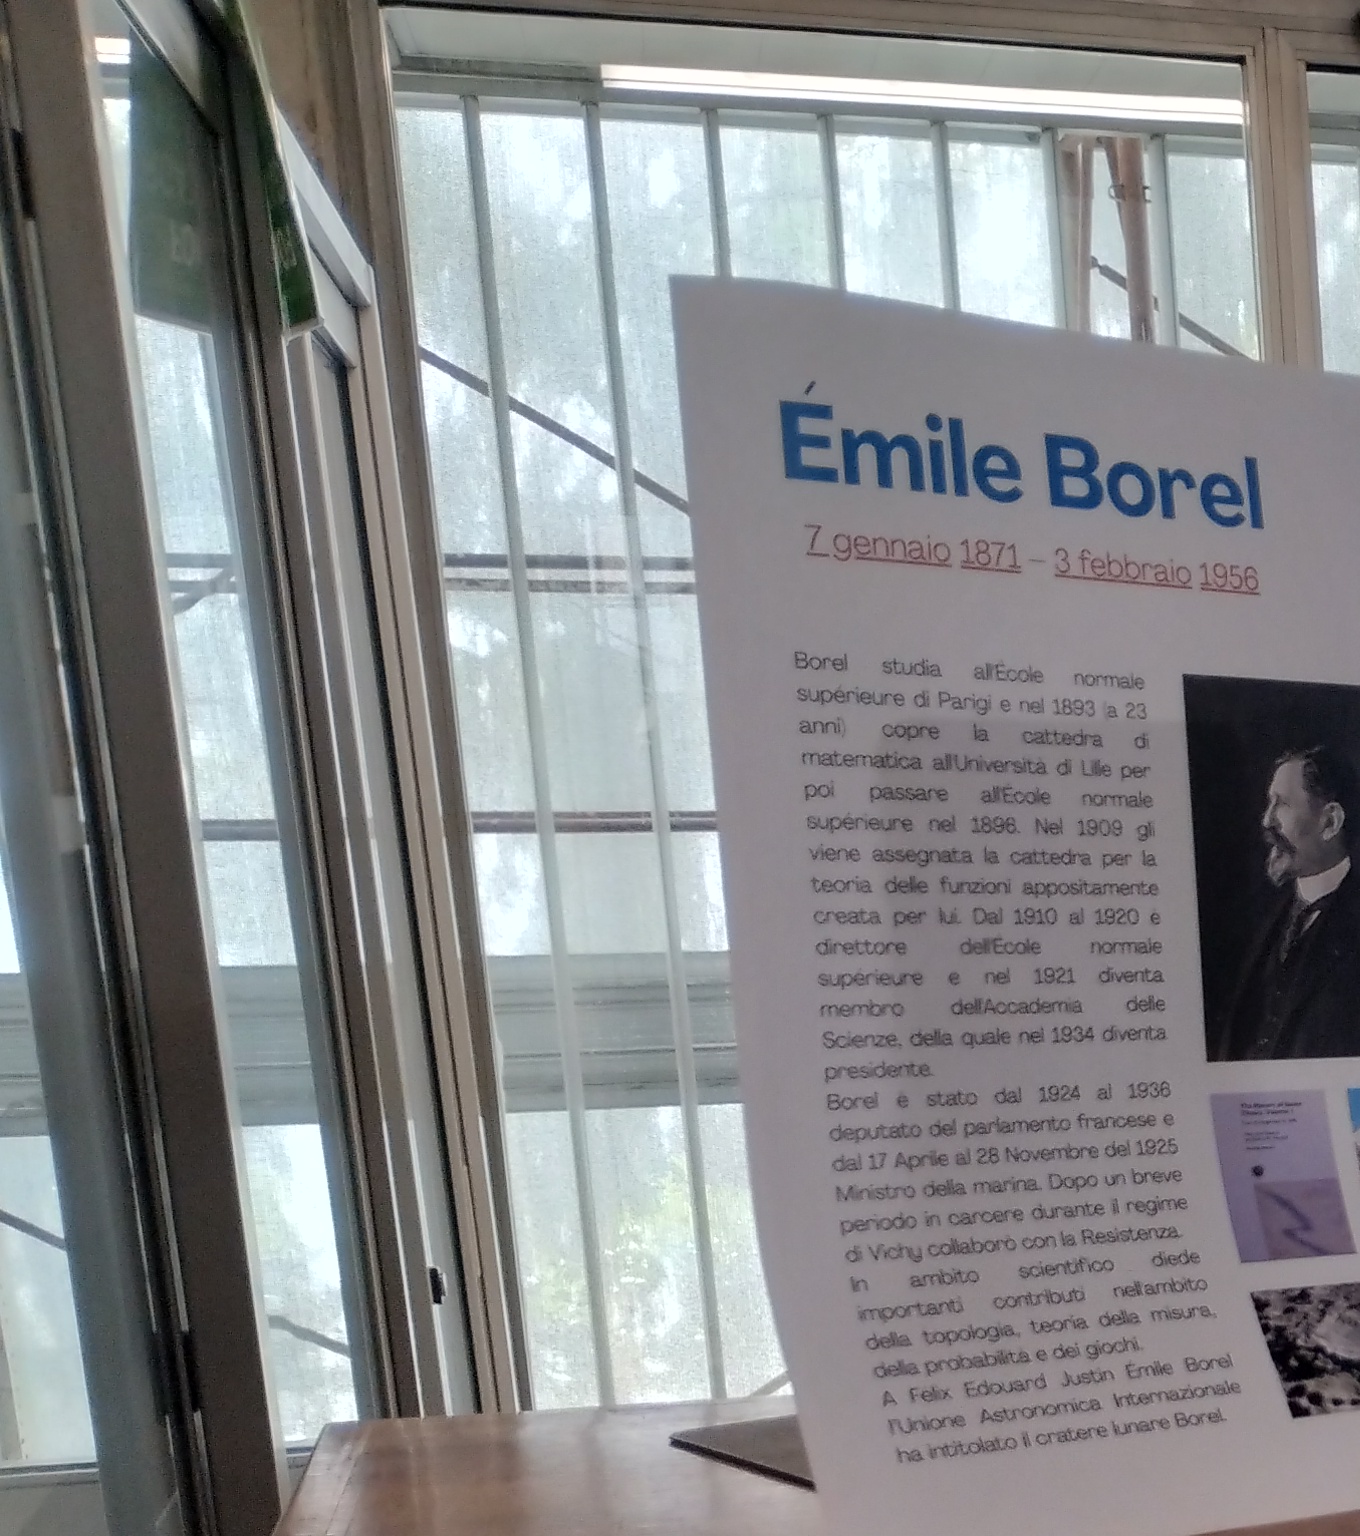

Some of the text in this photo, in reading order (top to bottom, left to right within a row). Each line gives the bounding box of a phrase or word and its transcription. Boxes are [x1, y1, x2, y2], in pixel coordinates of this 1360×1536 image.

[779, 381, 1264, 530] Émile Borel
[804, 524, 825, 556] 7
[832, 531, 951, 566] gennaio
[960, 541, 1021, 573] 1871
[1054, 548, 1070, 576] 3
[1078, 550, 1192, 588] febbraio
[1200, 563, 1261, 596] 1956
[793, 650, 849, 672] Borel
[881, 657, 943, 678] studia
[1073, 672, 1146, 691] normale
[801, 750, 924, 771] matematica
[1056, 758, 1072, 777] di
[1120, 764, 1151, 782] per
[803, 780, 835, 802] poi
[869, 786, 949, 804] passare
[1081, 790, 1154, 809] normale
[806, 812, 914, 835] supérieure
[928, 814, 957, 833] nel
[1034, 817, 1064, 836] Nel
[1077, 818, 1124, 837] 1909
[1135, 820, 1156, 843] gli
[808, 843, 1159, 870] viene assegnata la cattedra per la
[809, 875, 1160, 899] teoria delle funzioni appositamente
[815, 937, 908, 957] direttore
[1090, 937, 1163, 955] normale
[818, 994, 1166, 1018] membro dell'Accademia delle
[826, 1091, 879, 1111] Borel
[926, 1089, 978, 1108] stato
[993, 1086, 1022, 1105] dal
[1038, 1084, 1081, 1104] 1924
[1096, 1082, 1113, 1101] al
[828, 1122, 923, 1144] deputato
[928, 1118, 958, 1138] del
[963, 1115, 1072, 1139] parlamento
[1075, 1112, 1157, 1130] francese
[908, 1268, 980, 1289] ambito
[1150, 1248, 1201, 1268] diede
